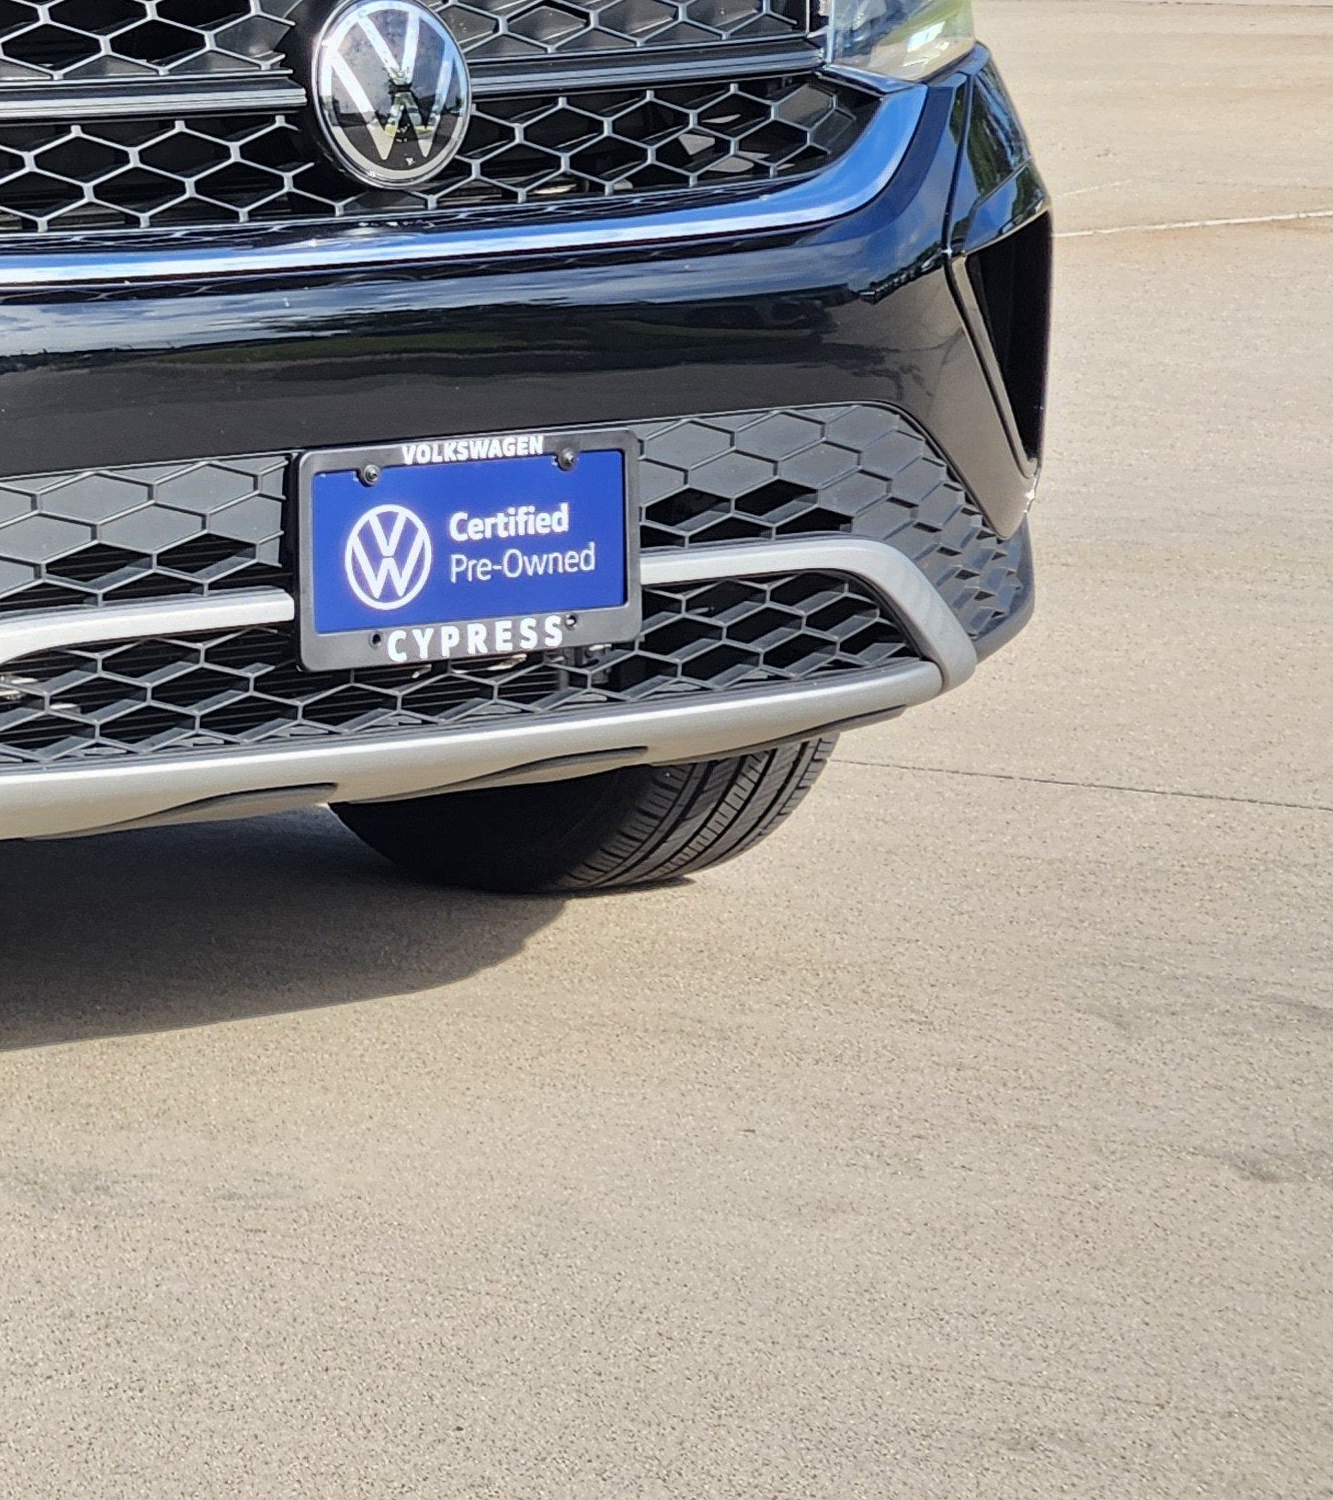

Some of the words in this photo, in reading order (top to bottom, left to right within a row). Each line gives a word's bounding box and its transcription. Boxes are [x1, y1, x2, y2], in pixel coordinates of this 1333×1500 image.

[402, 436, 544, 465] VOLKSWAGEN
[449, 503, 569, 541] Certified
[345, 504, 432, 610] VW
[450, 542, 596, 584] Pre-Owned
[387, 615, 564, 662] CYPRESS
